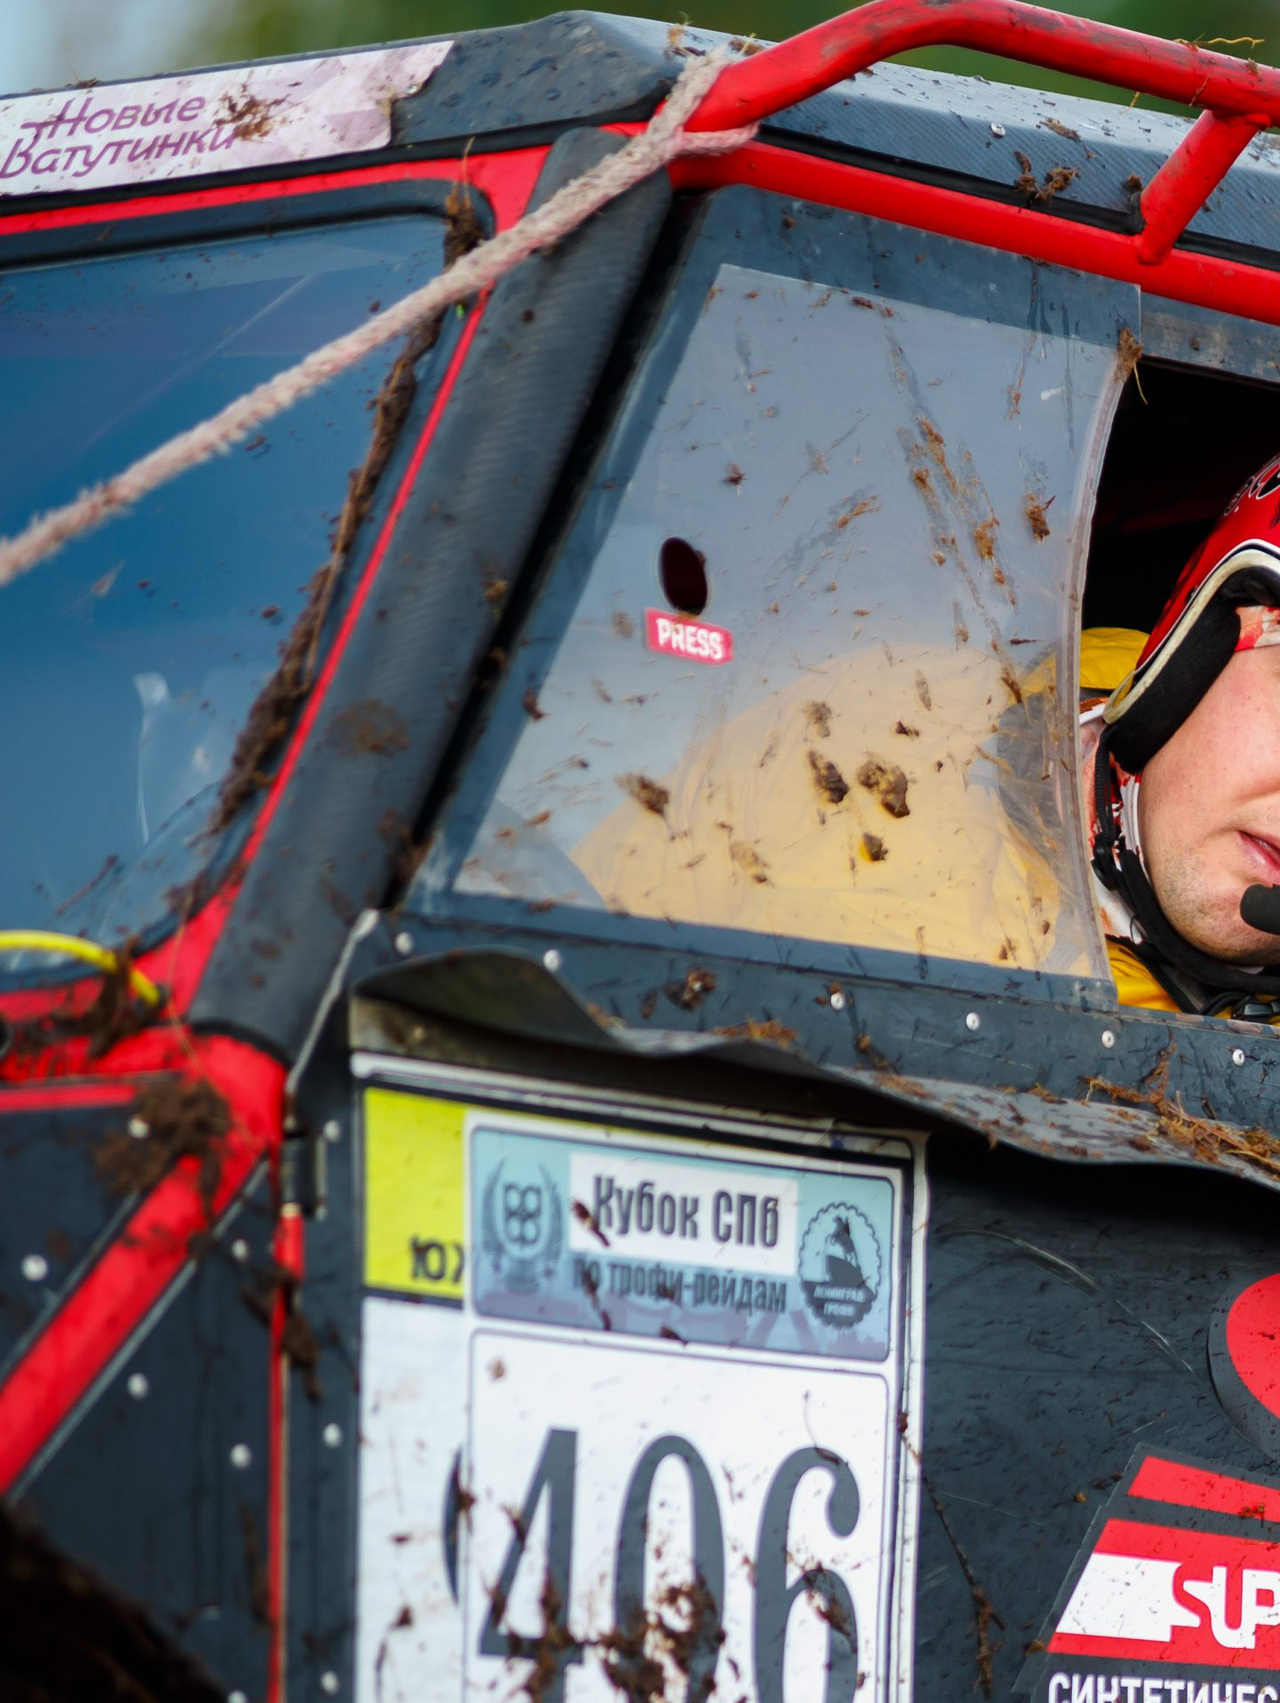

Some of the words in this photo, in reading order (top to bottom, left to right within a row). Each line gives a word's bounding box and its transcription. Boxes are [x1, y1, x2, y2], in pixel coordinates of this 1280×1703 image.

[20, 96, 206, 140] Новые
[0, 127, 240, 179] Ватутинки
[656, 618, 723, 660] PRESS
[593, 1176, 699, 1236] Кубок
[713, 1190, 779, 1248] СПб
[478, 1427, 861, 1703] 406
